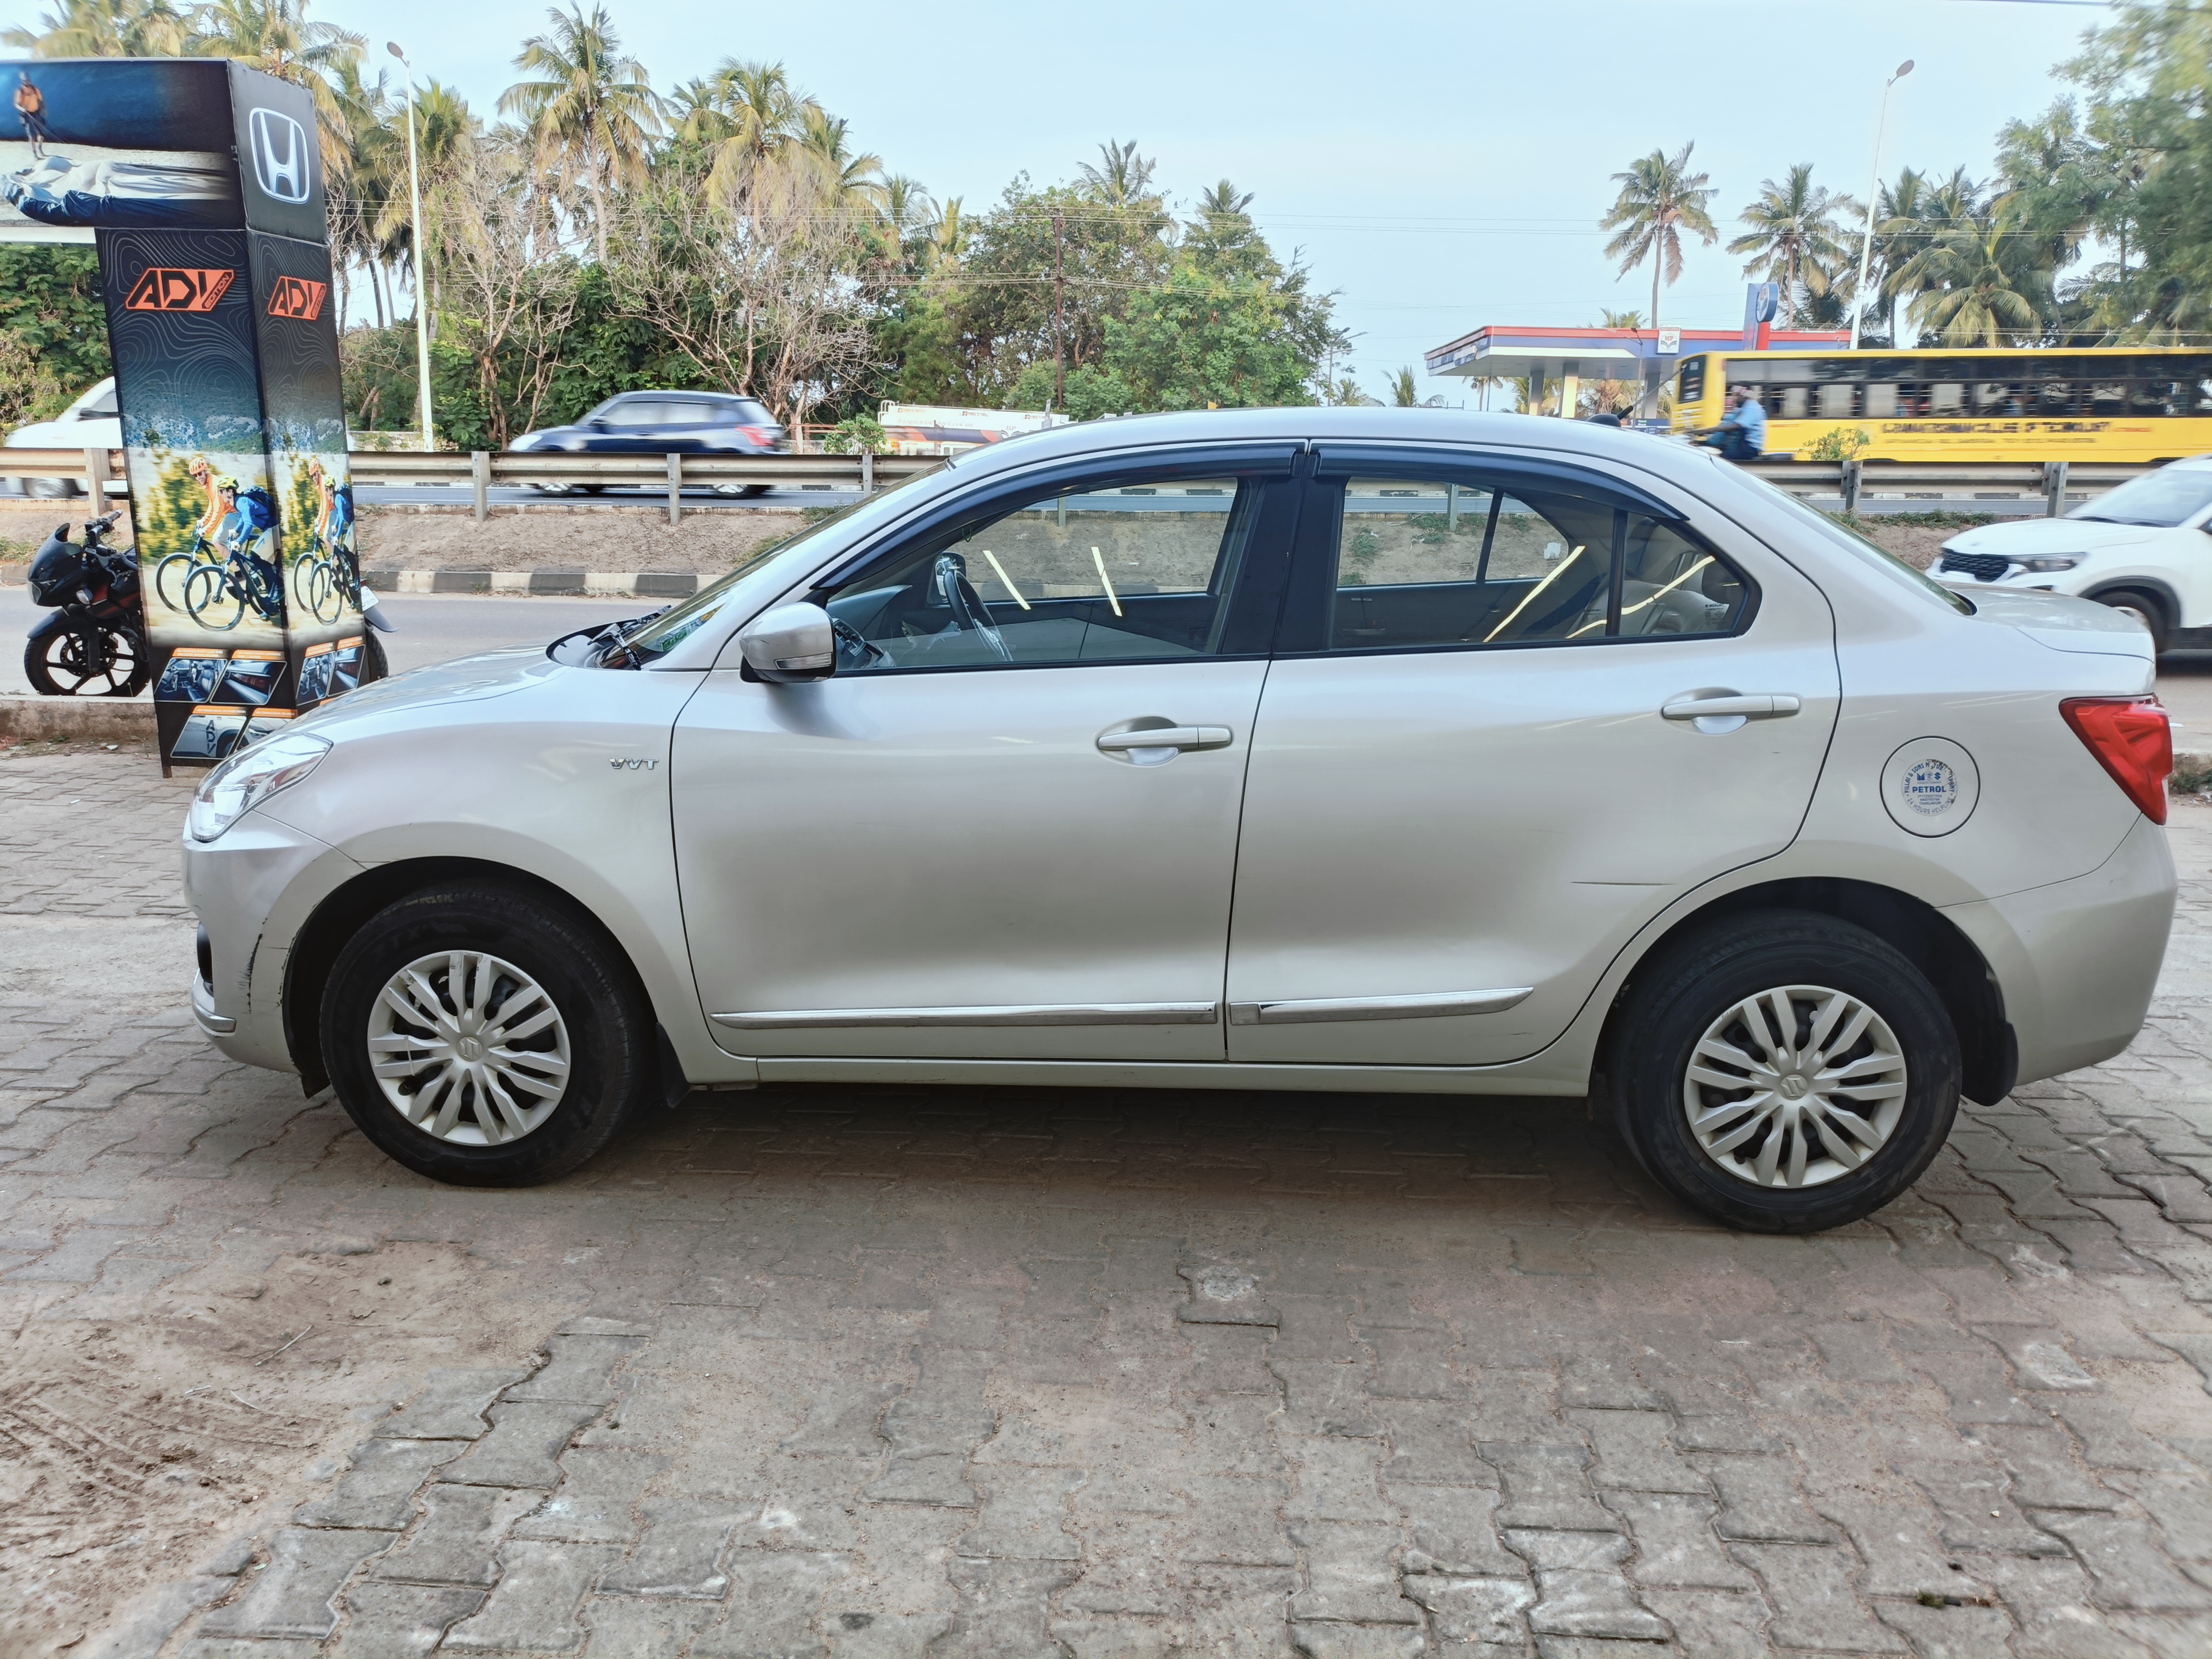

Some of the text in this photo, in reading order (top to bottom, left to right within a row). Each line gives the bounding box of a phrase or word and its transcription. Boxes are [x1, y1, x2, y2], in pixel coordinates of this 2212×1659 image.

[204, 274, 230, 308] EDITION
[206, 719, 216, 754] ADV
[609, 757, 659, 770] VVT
[1911, 763, 1924, 774] SONS
[1925, 762, 1944, 771] MTOR
[1913, 804, 1930, 814] HOURS
[1932, 796, 1951, 814] HELPLINE
